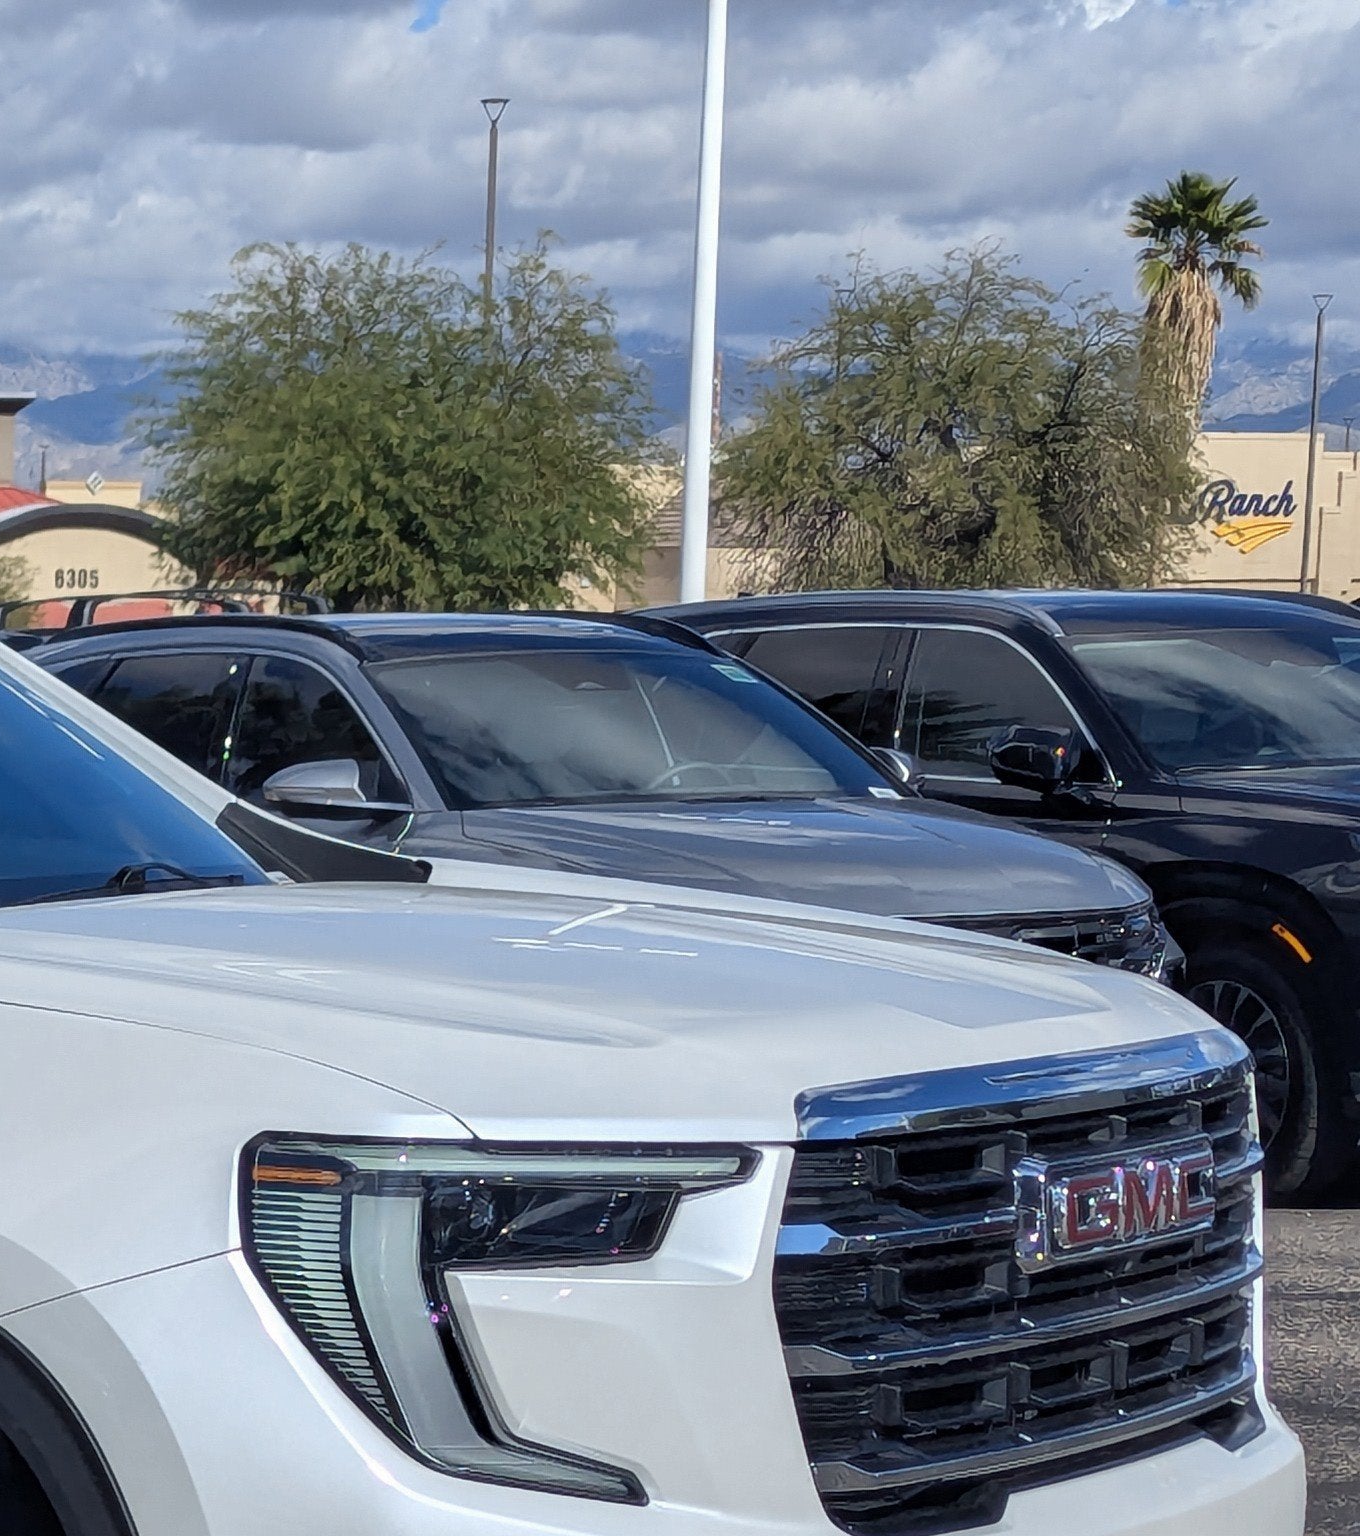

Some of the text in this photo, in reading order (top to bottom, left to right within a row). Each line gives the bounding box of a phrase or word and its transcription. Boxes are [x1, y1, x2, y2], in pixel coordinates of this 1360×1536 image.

[1173, 479, 1298, 524] Ranch
[54, 568, 99, 589] 6305
[1050, 1158, 1216, 1249] GMC
